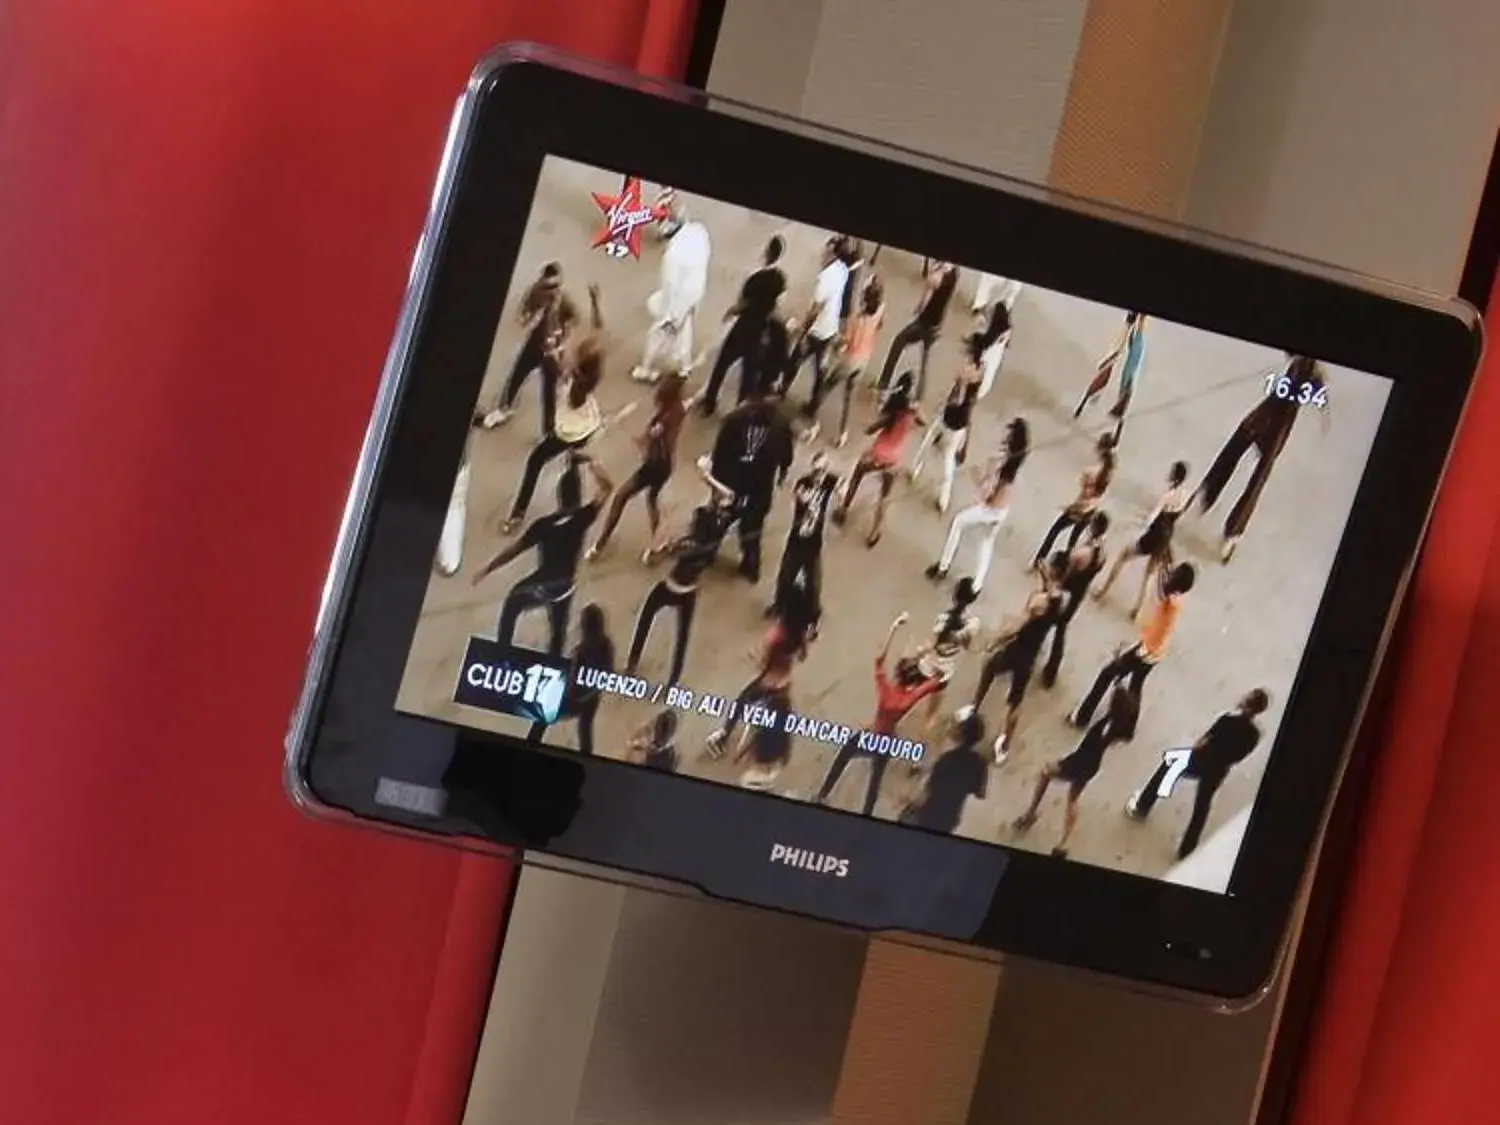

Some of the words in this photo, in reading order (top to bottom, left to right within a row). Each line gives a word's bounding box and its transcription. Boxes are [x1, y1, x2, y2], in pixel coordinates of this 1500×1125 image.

[607, 192, 653, 240] Virgin
[1265, 373, 1328, 408] 16.34
[576, 666, 647, 699] LUCENZO
[666, 686, 693, 708] BIG
[698, 694, 725, 718] ALI
[742, 704, 776, 728] VEM
[857, 730, 924, 761] KUDURO
[769, 843, 850, 877] PHILIPS
